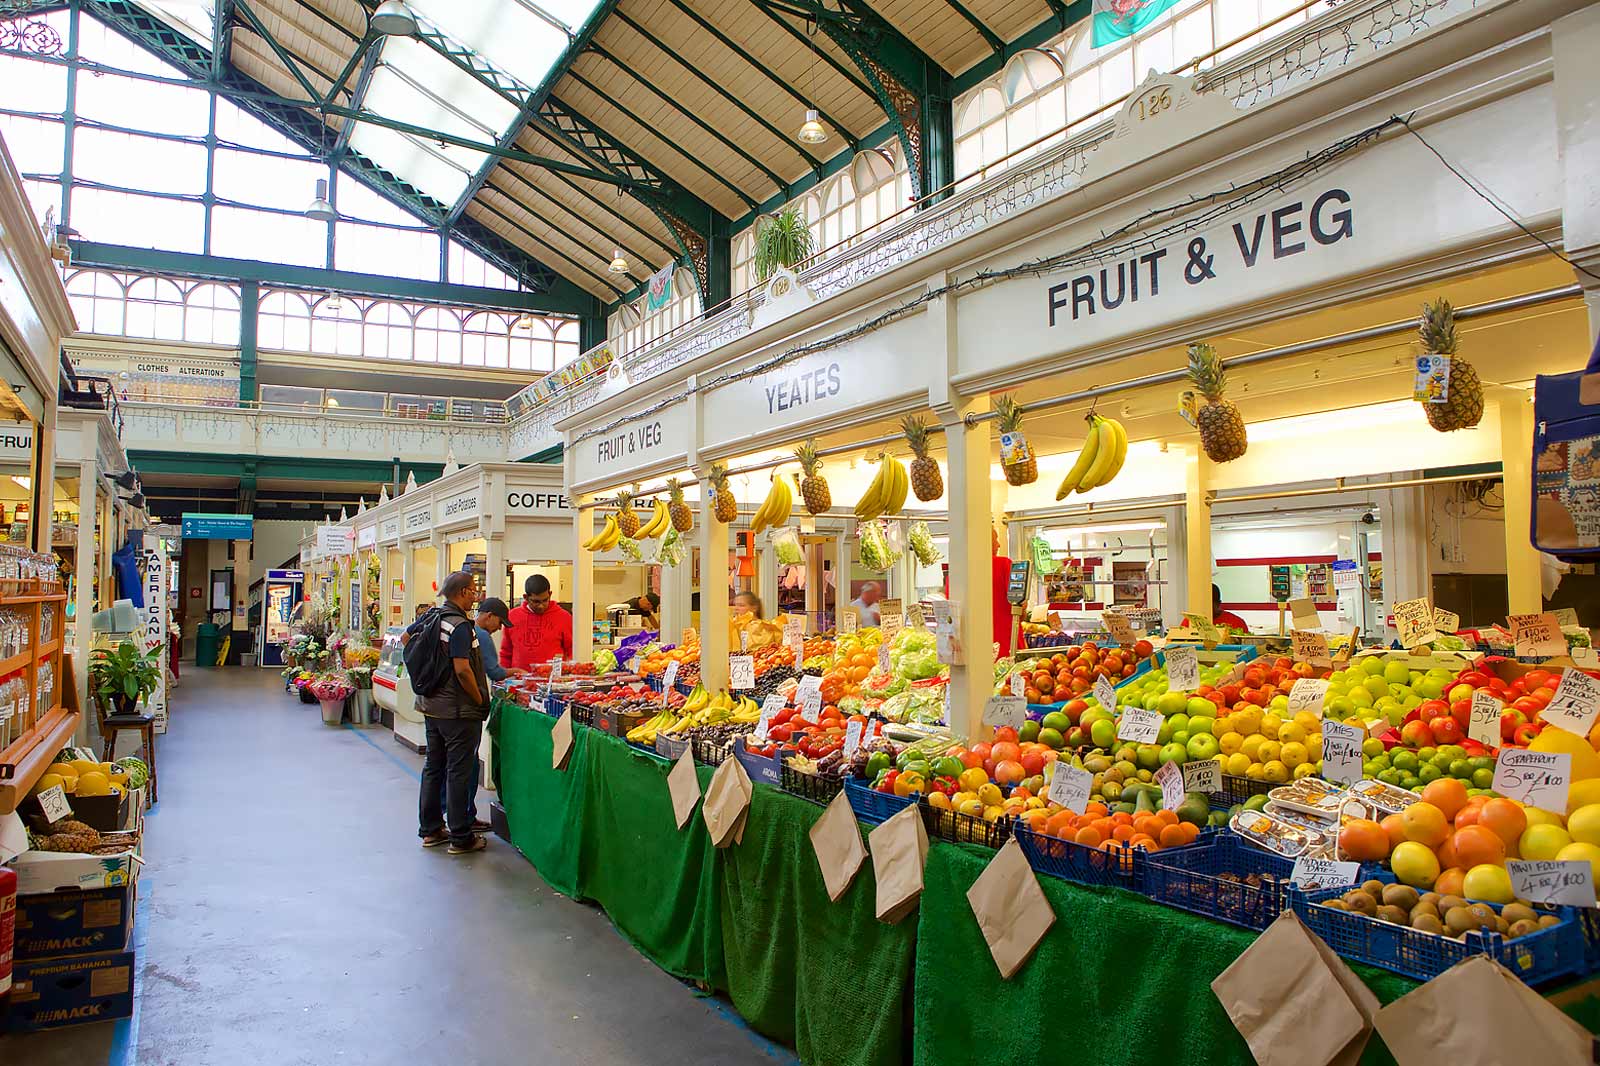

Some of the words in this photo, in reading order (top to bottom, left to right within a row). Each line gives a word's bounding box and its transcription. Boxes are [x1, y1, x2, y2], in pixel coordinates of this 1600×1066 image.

[1138, 87, 1172, 120] 126
[1049, 248, 1167, 327] FRUIT
[1184, 236, 1216, 285] &
[1232, 189, 1353, 268] VEG
[137, 364, 169, 373] CLOTHES
[179, 367, 225, 377] ALTERATIONS
[765, 363, 841, 414] YEATES
[598, 435, 626, 464] FRUIT
[628, 433, 636, 453] &
[637, 422, 662, 450] VEG
[148, 554, 161, 635] AMERICAN
[1568, 669, 1592, 684] LARGE
[1561, 687, 1597, 703] MELONS
[1324, 722, 1354, 737] DATES
[1501, 749, 1559, 767] GRAPEFRUIT
[1500, 768, 1522, 788] 3
[1520, 878, 1537, 893] 4
[46, 936, 93, 950] MACK
[29, 966, 69, 976] PREMIUM
[70, 960, 113, 971] BANANAS
[53, 1003, 102, 1021] MACK
